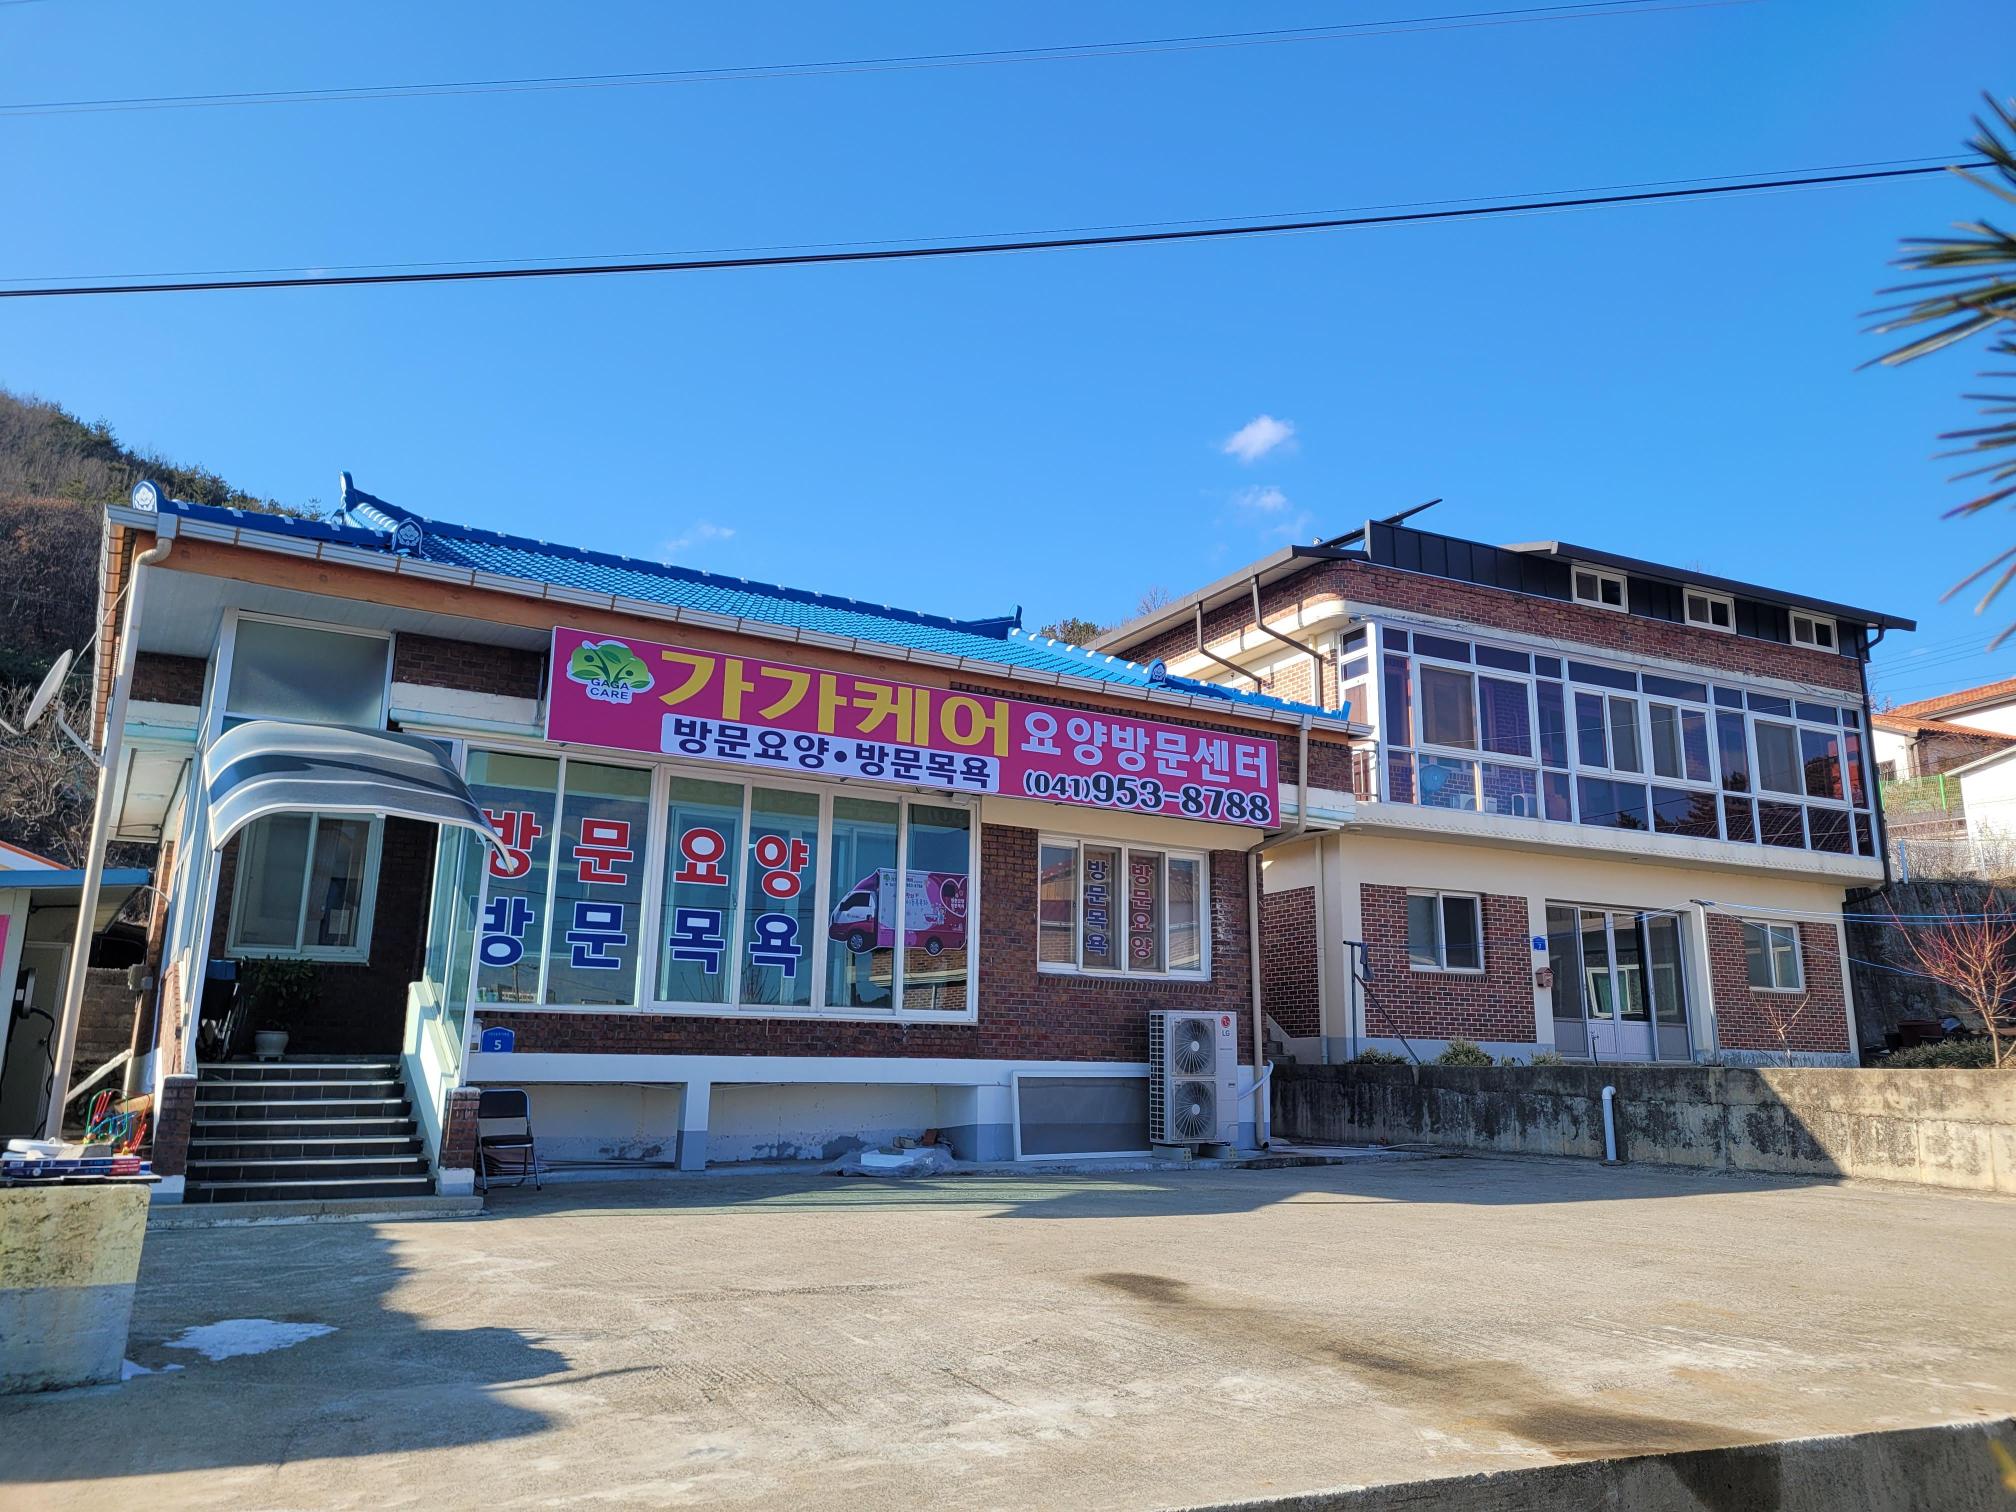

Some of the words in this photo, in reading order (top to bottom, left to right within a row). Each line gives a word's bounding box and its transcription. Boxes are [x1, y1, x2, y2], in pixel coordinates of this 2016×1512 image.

[590, 687, 629, 700] CARE
[591, 677, 630, 690] GAGA
[658, 649, 1009, 757] 가가케어
[1020, 711, 1268, 789] 요양방문센터
[1024, 771, 1272, 823] (041)953-8788
[1085, 858, 1109, 957] 방문목욕
[1130, 863, 1153, 960] 방문요양
[493, 1039, 502, 1051] 5
[1221, 1029, 1231, 1037] LG
